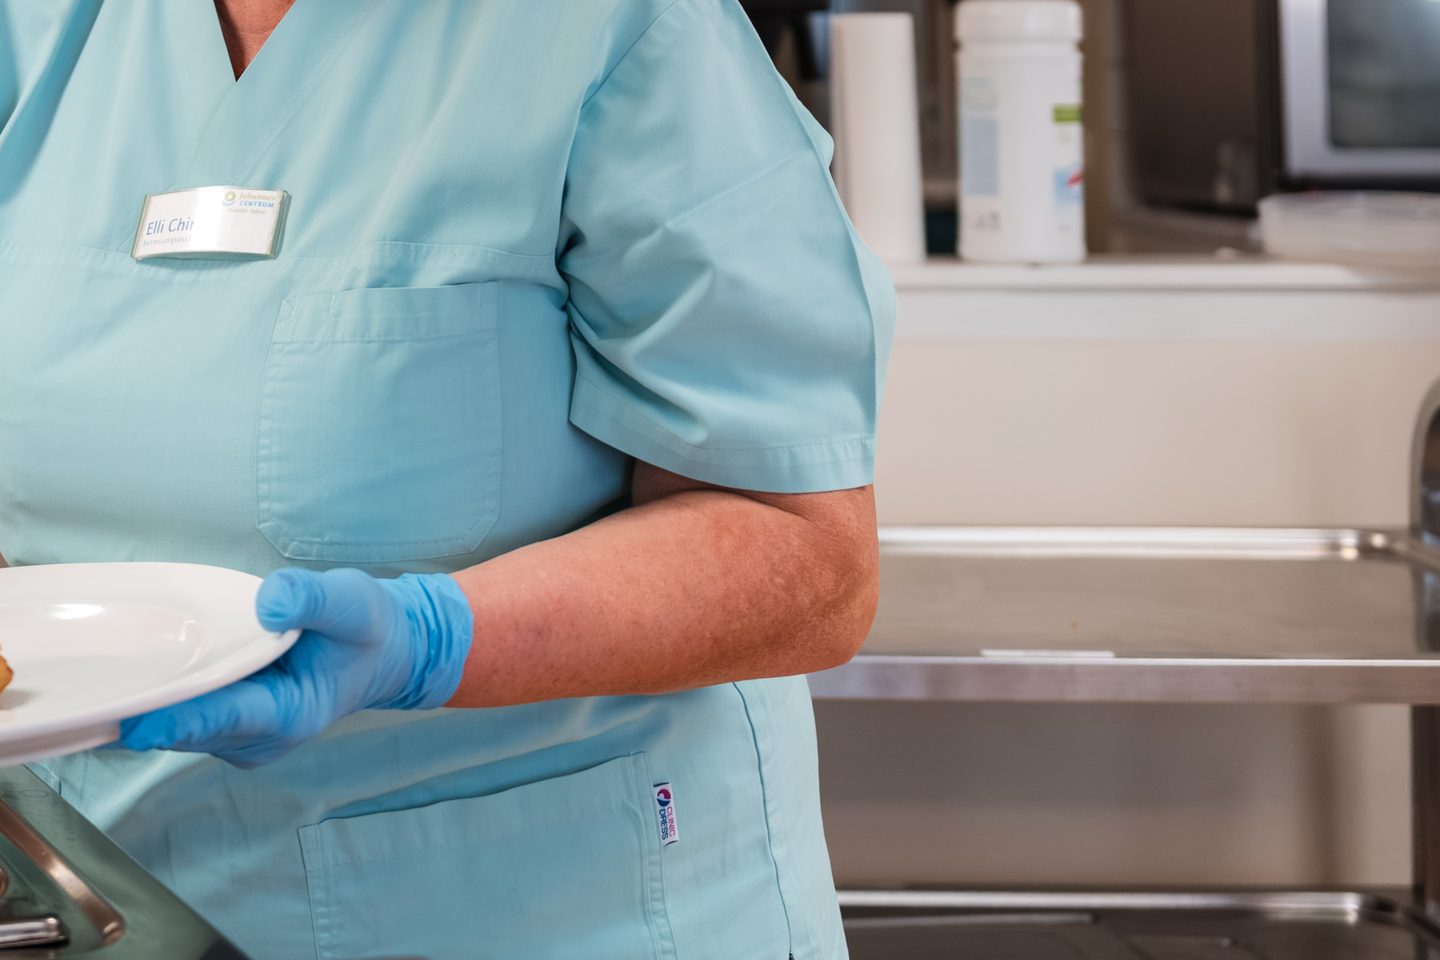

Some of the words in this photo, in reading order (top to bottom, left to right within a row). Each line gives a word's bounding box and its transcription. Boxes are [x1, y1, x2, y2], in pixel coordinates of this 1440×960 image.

[239, 200, 274, 208] CENTRUM
[146, 220, 165, 237] Elli
[659, 808, 668, 840] DRESS
[667, 806, 676, 838] CLINIC
